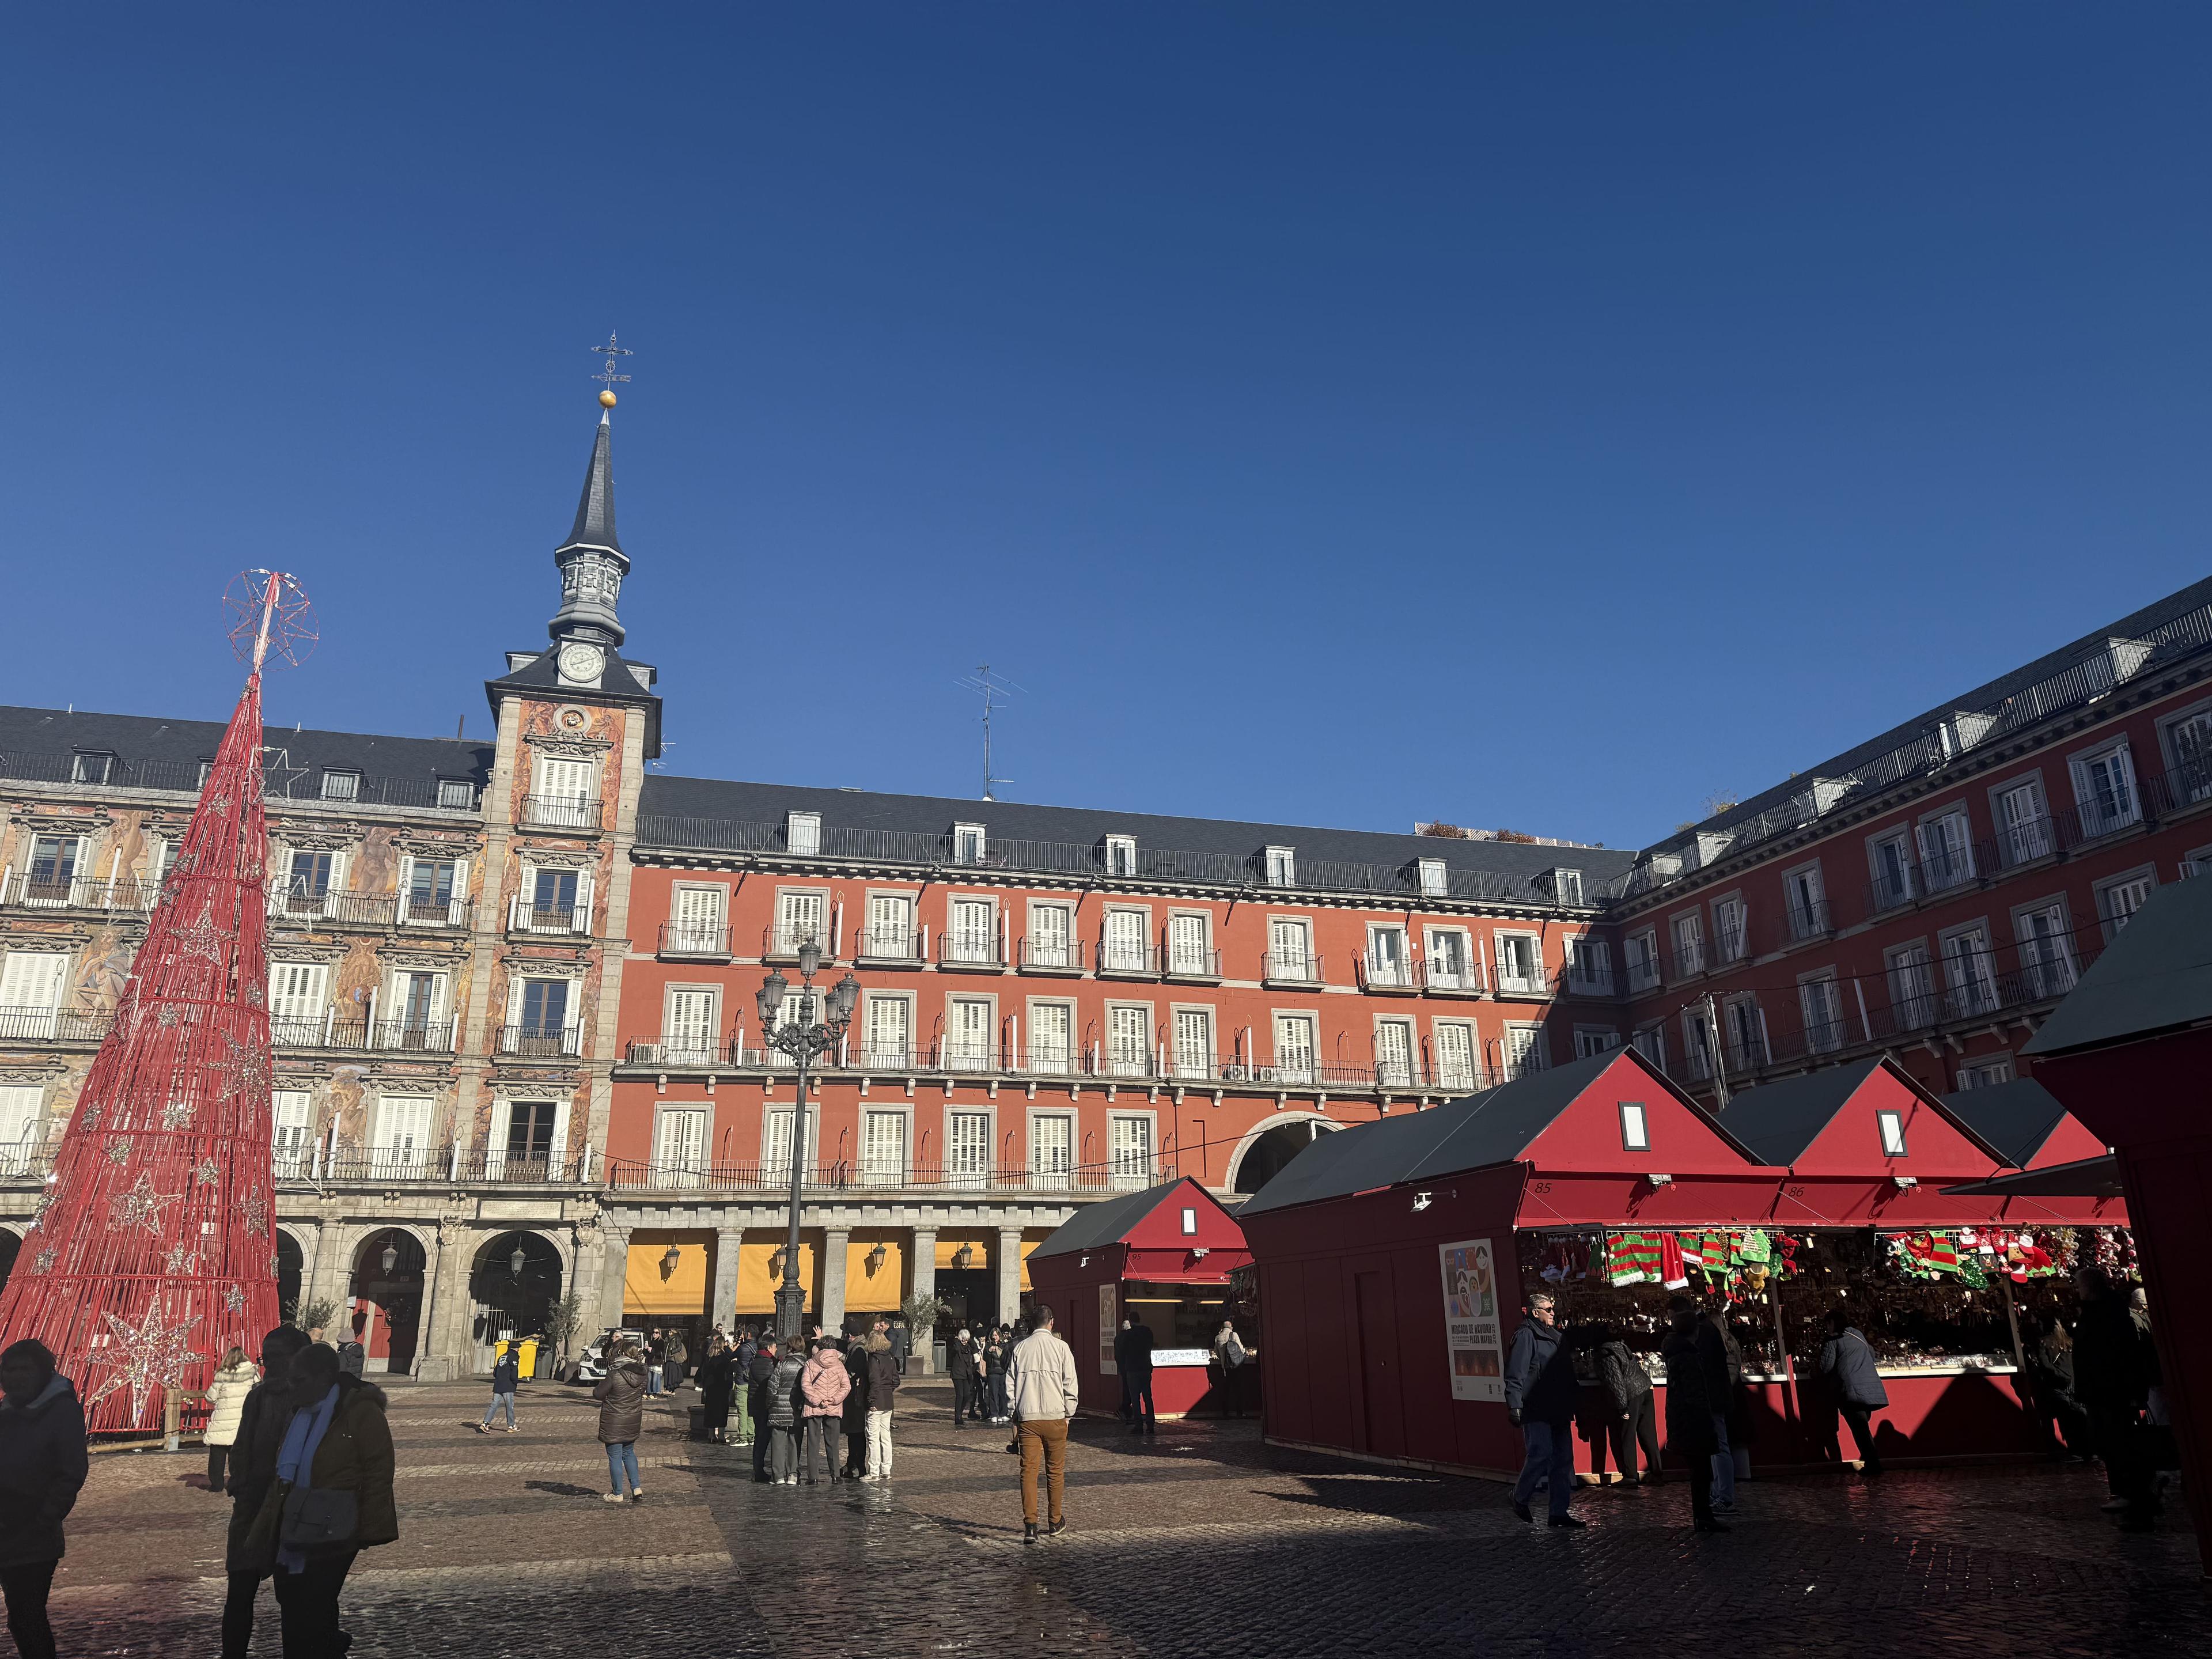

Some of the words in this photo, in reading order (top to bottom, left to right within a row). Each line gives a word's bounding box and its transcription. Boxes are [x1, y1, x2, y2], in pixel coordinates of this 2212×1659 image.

[1535, 1183, 1552, 1194] 85
[1789, 1187, 1805, 1197] 86
[1452, 1324, 1468, 1334] MERCADO
[1468, 1324, 1474, 1334] DE
[1475, 1323, 1491, 1334] NAVIDAD
[1469, 1335, 1480, 1344] PLAZA
[1480, 1335, 1493, 1344] MAYOR
